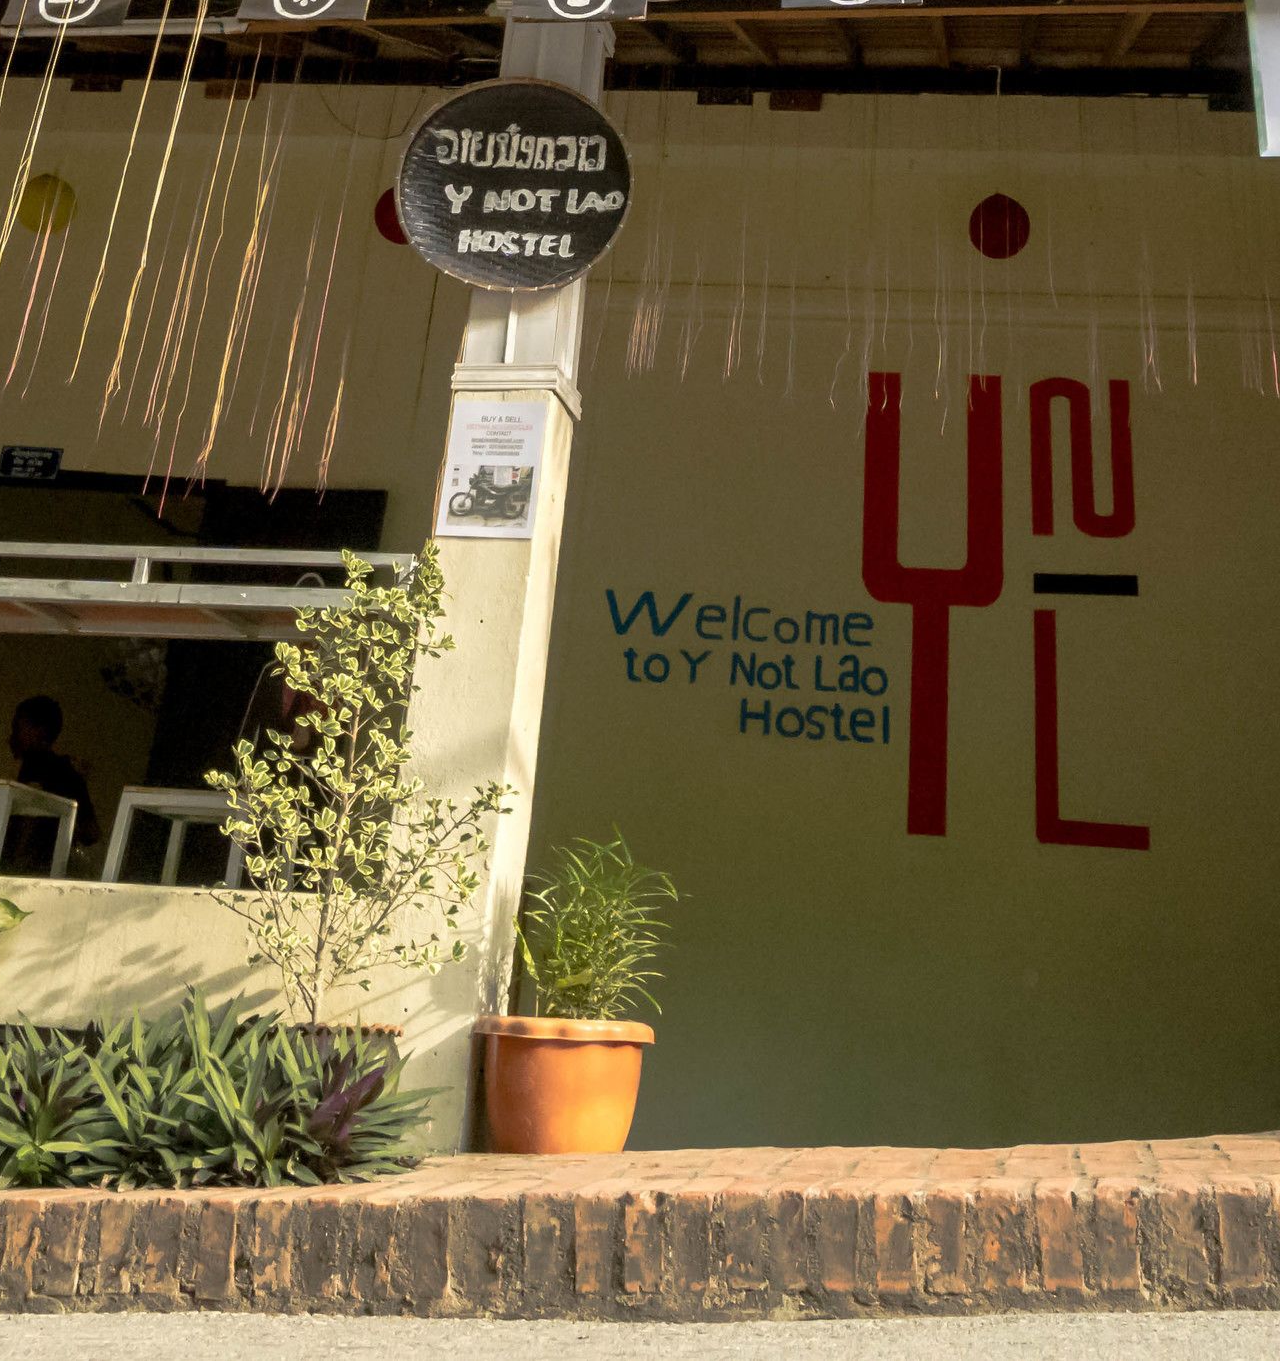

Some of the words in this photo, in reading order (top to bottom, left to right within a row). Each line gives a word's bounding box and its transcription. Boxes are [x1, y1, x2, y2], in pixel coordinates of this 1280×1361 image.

[444, 183, 473, 214] Y
[483, 189, 561, 213] NOT
[566, 188, 625, 215] LAO
[457, 229, 575, 258] HOSTEL
[605, 589, 874, 647] Welcome
[623, 646, 671, 684] to
[680, 648, 713, 684] Y
[728, 651, 800, 690] Not
[815, 653, 889, 697] Lao
[738, 697, 891, 745] Hostel
